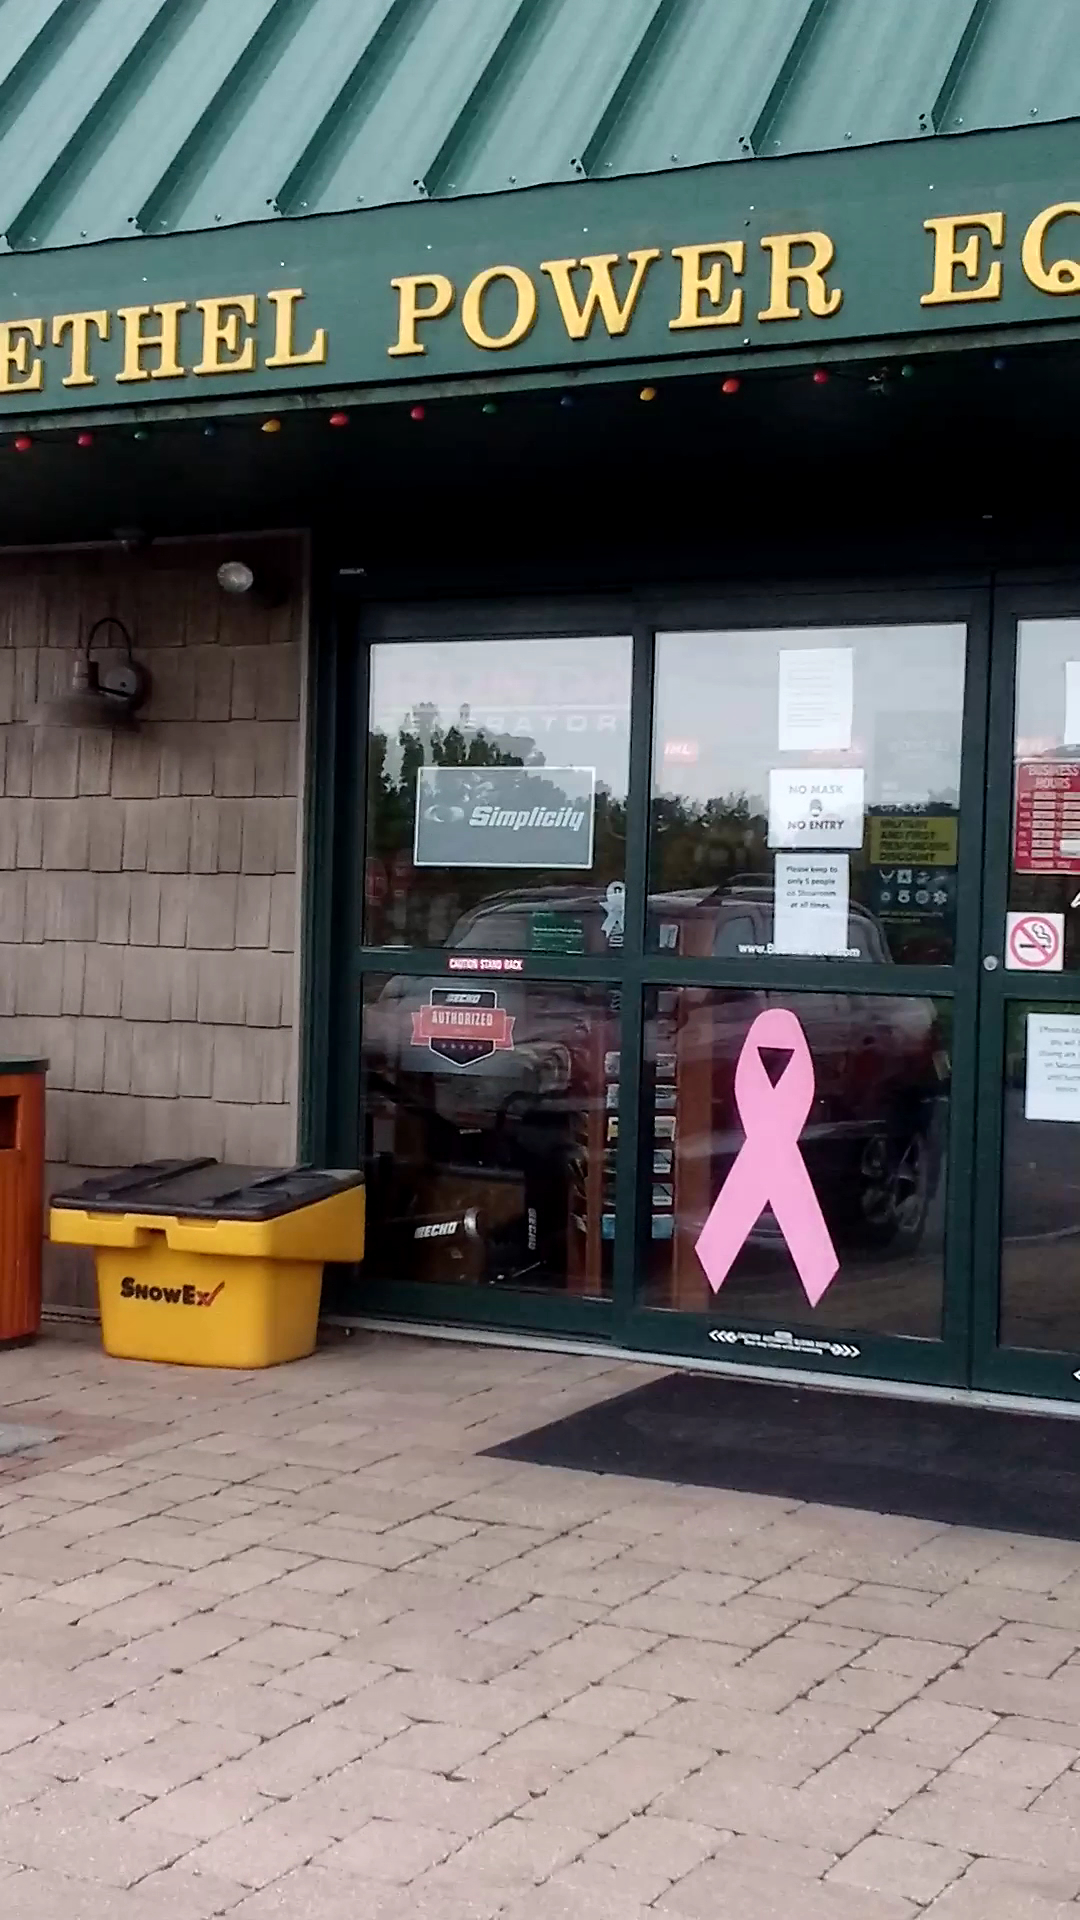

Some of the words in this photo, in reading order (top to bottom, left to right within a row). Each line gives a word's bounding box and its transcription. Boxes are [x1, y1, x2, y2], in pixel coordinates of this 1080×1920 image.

[387, 230, 843, 358] POWER
[788, 784, 807, 795] NO
[810, 784, 844, 795] MASK
[469, 805, 585, 832] Simplicity
[787, 820, 807, 830] NO
[809, 820, 845, 830] ENTRY
[810, 878, 836, 887] people
[449, 958, 479, 970] CAUTION
[480, 958, 503, 970] STAND
[503, 958, 524, 971] BACK
[431, 1010, 494, 1027] AUTHORIZED
[415, 1220, 460, 1239] ECHO
